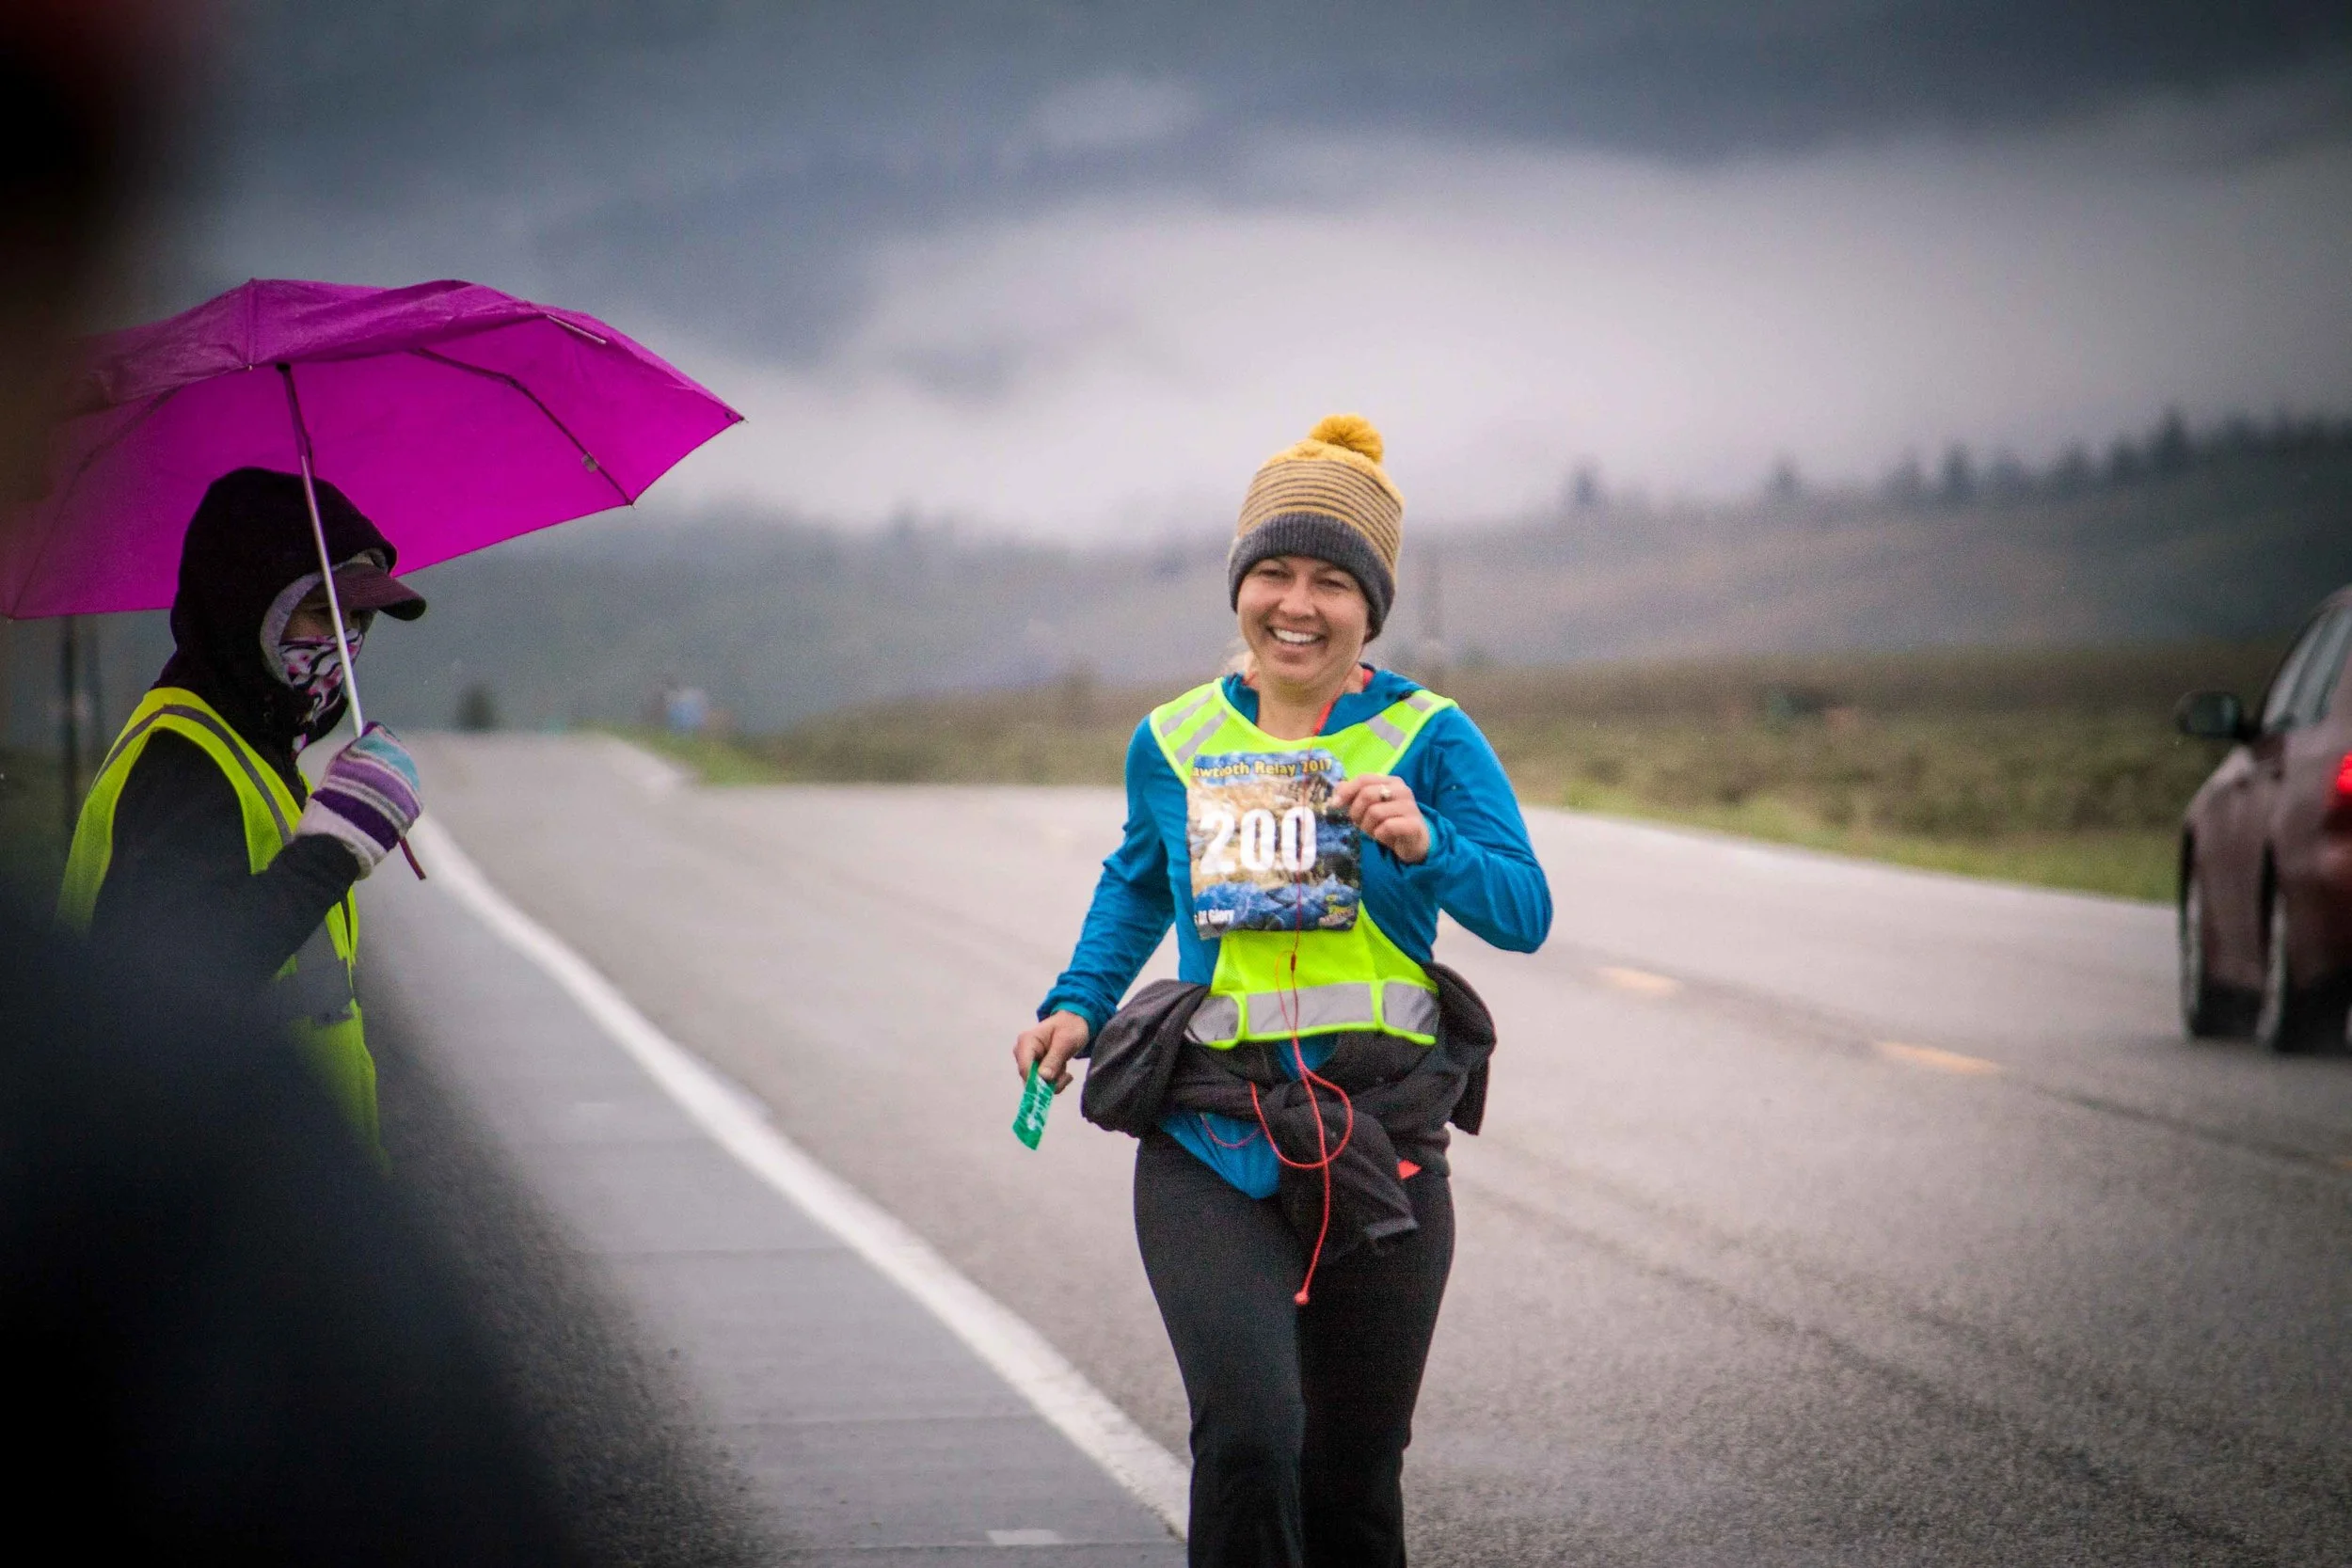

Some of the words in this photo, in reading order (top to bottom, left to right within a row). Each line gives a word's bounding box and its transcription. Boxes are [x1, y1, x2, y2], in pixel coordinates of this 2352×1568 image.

[1192, 761, 1250, 778] awtooth
[1254, 760, 1296, 777] Relay
[1199, 805, 1317, 876] 200
